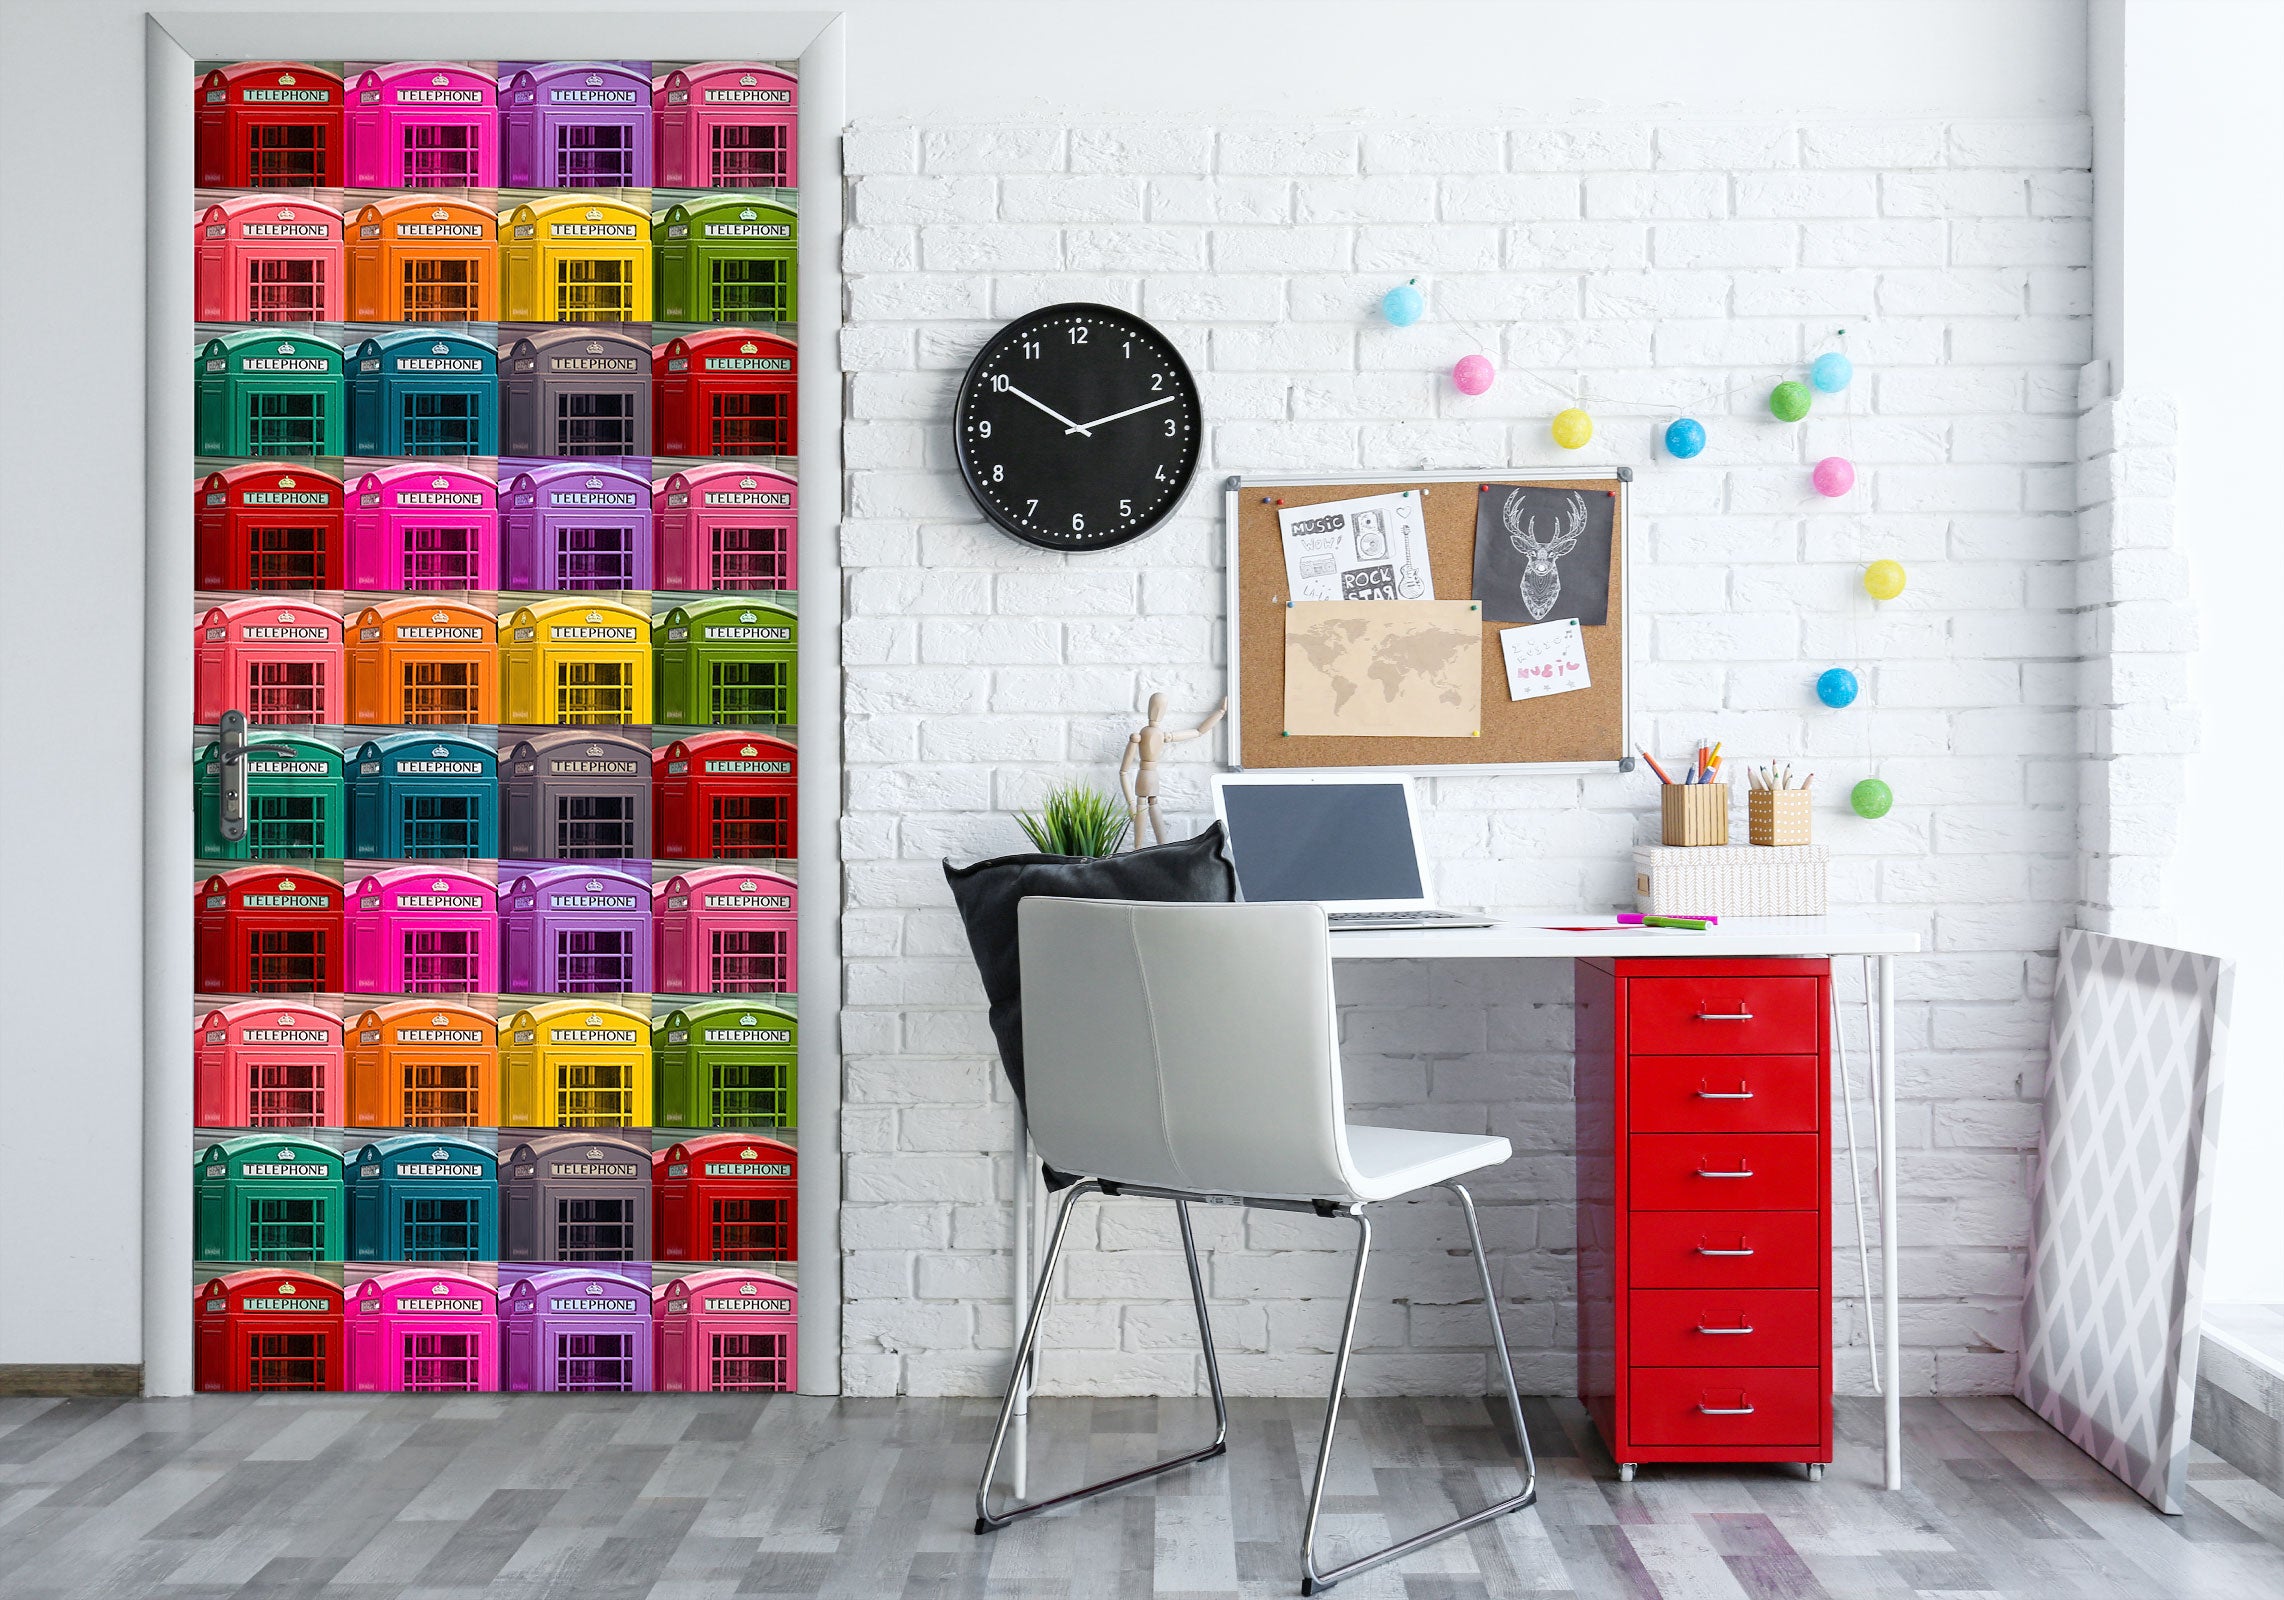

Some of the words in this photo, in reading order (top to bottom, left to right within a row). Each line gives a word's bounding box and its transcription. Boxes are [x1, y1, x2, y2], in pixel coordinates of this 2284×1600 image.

[245, 90, 326, 101] TELEPHONE
[398, 90, 479, 101] TELEPHONE
[552, 90, 633, 101] TELEPHONE
[706, 90, 787, 101] TELEPHONE
[244, 225, 325, 236] TELEPHONE
[398, 225, 479, 236] TELEPHONE
[552, 225, 633, 236] TELEPHONE
[706, 225, 787, 236] TELEPHONE
[1069, 327, 1088, 345] 12
[1023, 342, 1040, 360] 11
[1122, 342, 1130, 359] 1
[244, 359, 325, 370] TELEPHONE
[398, 359, 479, 370] TELEPHONE
[553, 359, 634, 370] TELEPHONE
[707, 359, 788, 370] TELEPHONE
[990, 375, 1010, 392] 10
[1151, 374, 1163, 391] 2
[979, 421, 992, 438] 9
[1165, 419, 1176, 437] 3
[993, 465, 1004, 482] 8
[1155, 465, 1166, 482] 4
[245, 493, 326, 504] TELEPHONE
[398, 493, 479, 504] TELEPHONE
[552, 493, 633, 504] TELEPHONE
[706, 493, 787, 504] TELEPHONE
[1026, 500, 1039, 517] 7
[1120, 500, 1132, 517] 5
[1072, 514, 1085, 531] 6
[1301, 535, 1343, 552] WOW!
[1345, 567, 1392, 589] ROCK
[244, 627, 325, 638] TELEPHONE
[398, 627, 479, 638] TELEPHONE
[552, 627, 633, 638] TELEPHONE
[706, 627, 787, 638] TELEPHONE
[398, 762, 479, 773] TELEPHONE
[553, 762, 634, 773] TELEPHONE
[707, 762, 788, 773] TELEPHONE
[245, 896, 326, 907] TELEPHONE
[398, 896, 479, 907] TELEPHONE
[552, 896, 633, 907] TELEPHONE
[706, 896, 787, 907] TELEPHONE
[244, 1030, 325, 1041] TELEPHONE
[398, 1030, 479, 1041] TELEPHONE
[552, 1030, 633, 1041] TELEPHONE
[706, 1030, 787, 1041] TELEPHONE
[244, 1164, 325, 1175] TELEPHONE
[398, 1164, 479, 1175] TELEPHONE
[553, 1164, 634, 1175] TELEPHONE
[707, 1164, 788, 1175] TELEPHONE
[245, 1299, 326, 1310] TELEPHONE
[398, 1299, 479, 1310] TELEPHONE
[552, 1299, 633, 1310] TELEPHONE
[706, 1299, 787, 1310] TELEPHONE
